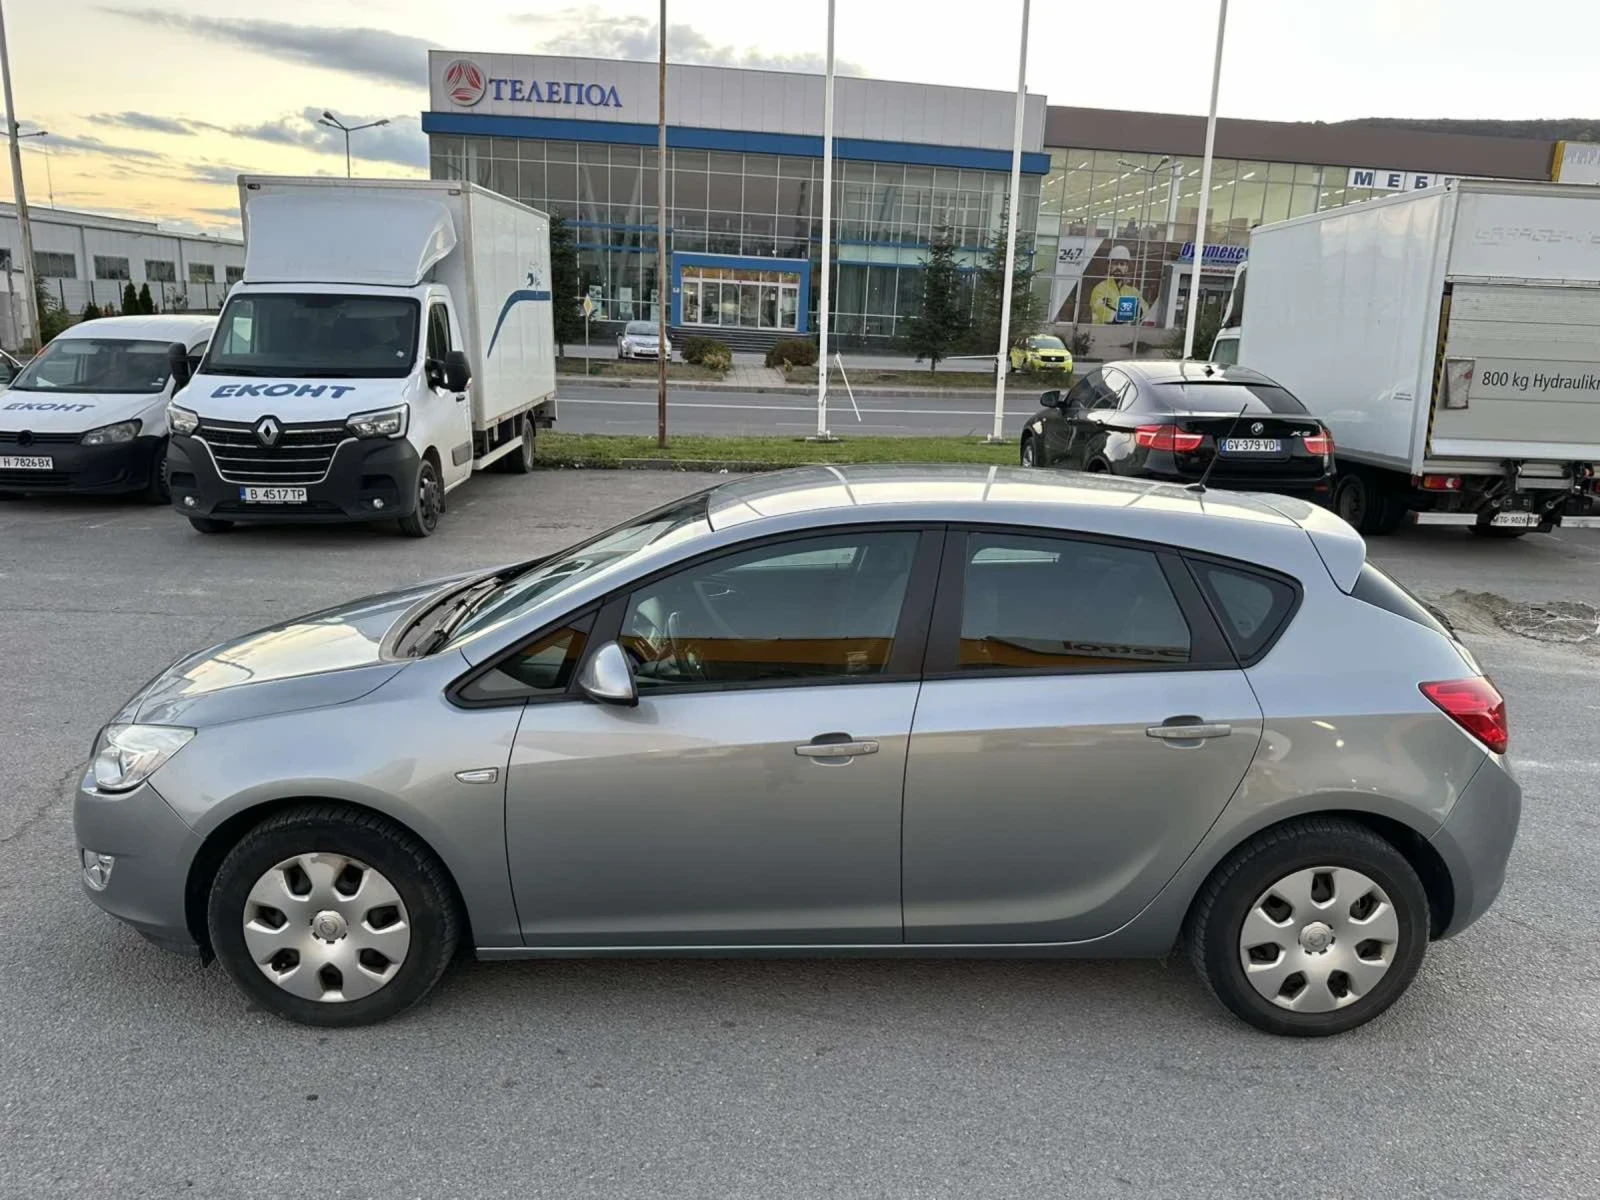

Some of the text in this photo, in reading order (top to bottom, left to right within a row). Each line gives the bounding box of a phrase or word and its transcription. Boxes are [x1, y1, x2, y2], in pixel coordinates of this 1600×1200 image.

[488, 78, 622, 108] ТЕЛЕПОЛ
[1482, 371, 1509, 387] 800
[1512, 371, 1529, 391] kg
[210, 383, 356, 399] ЕКОНТ
[1227, 440, 1276, 450] GV-379-VD
[250, 489, 258, 499] B
